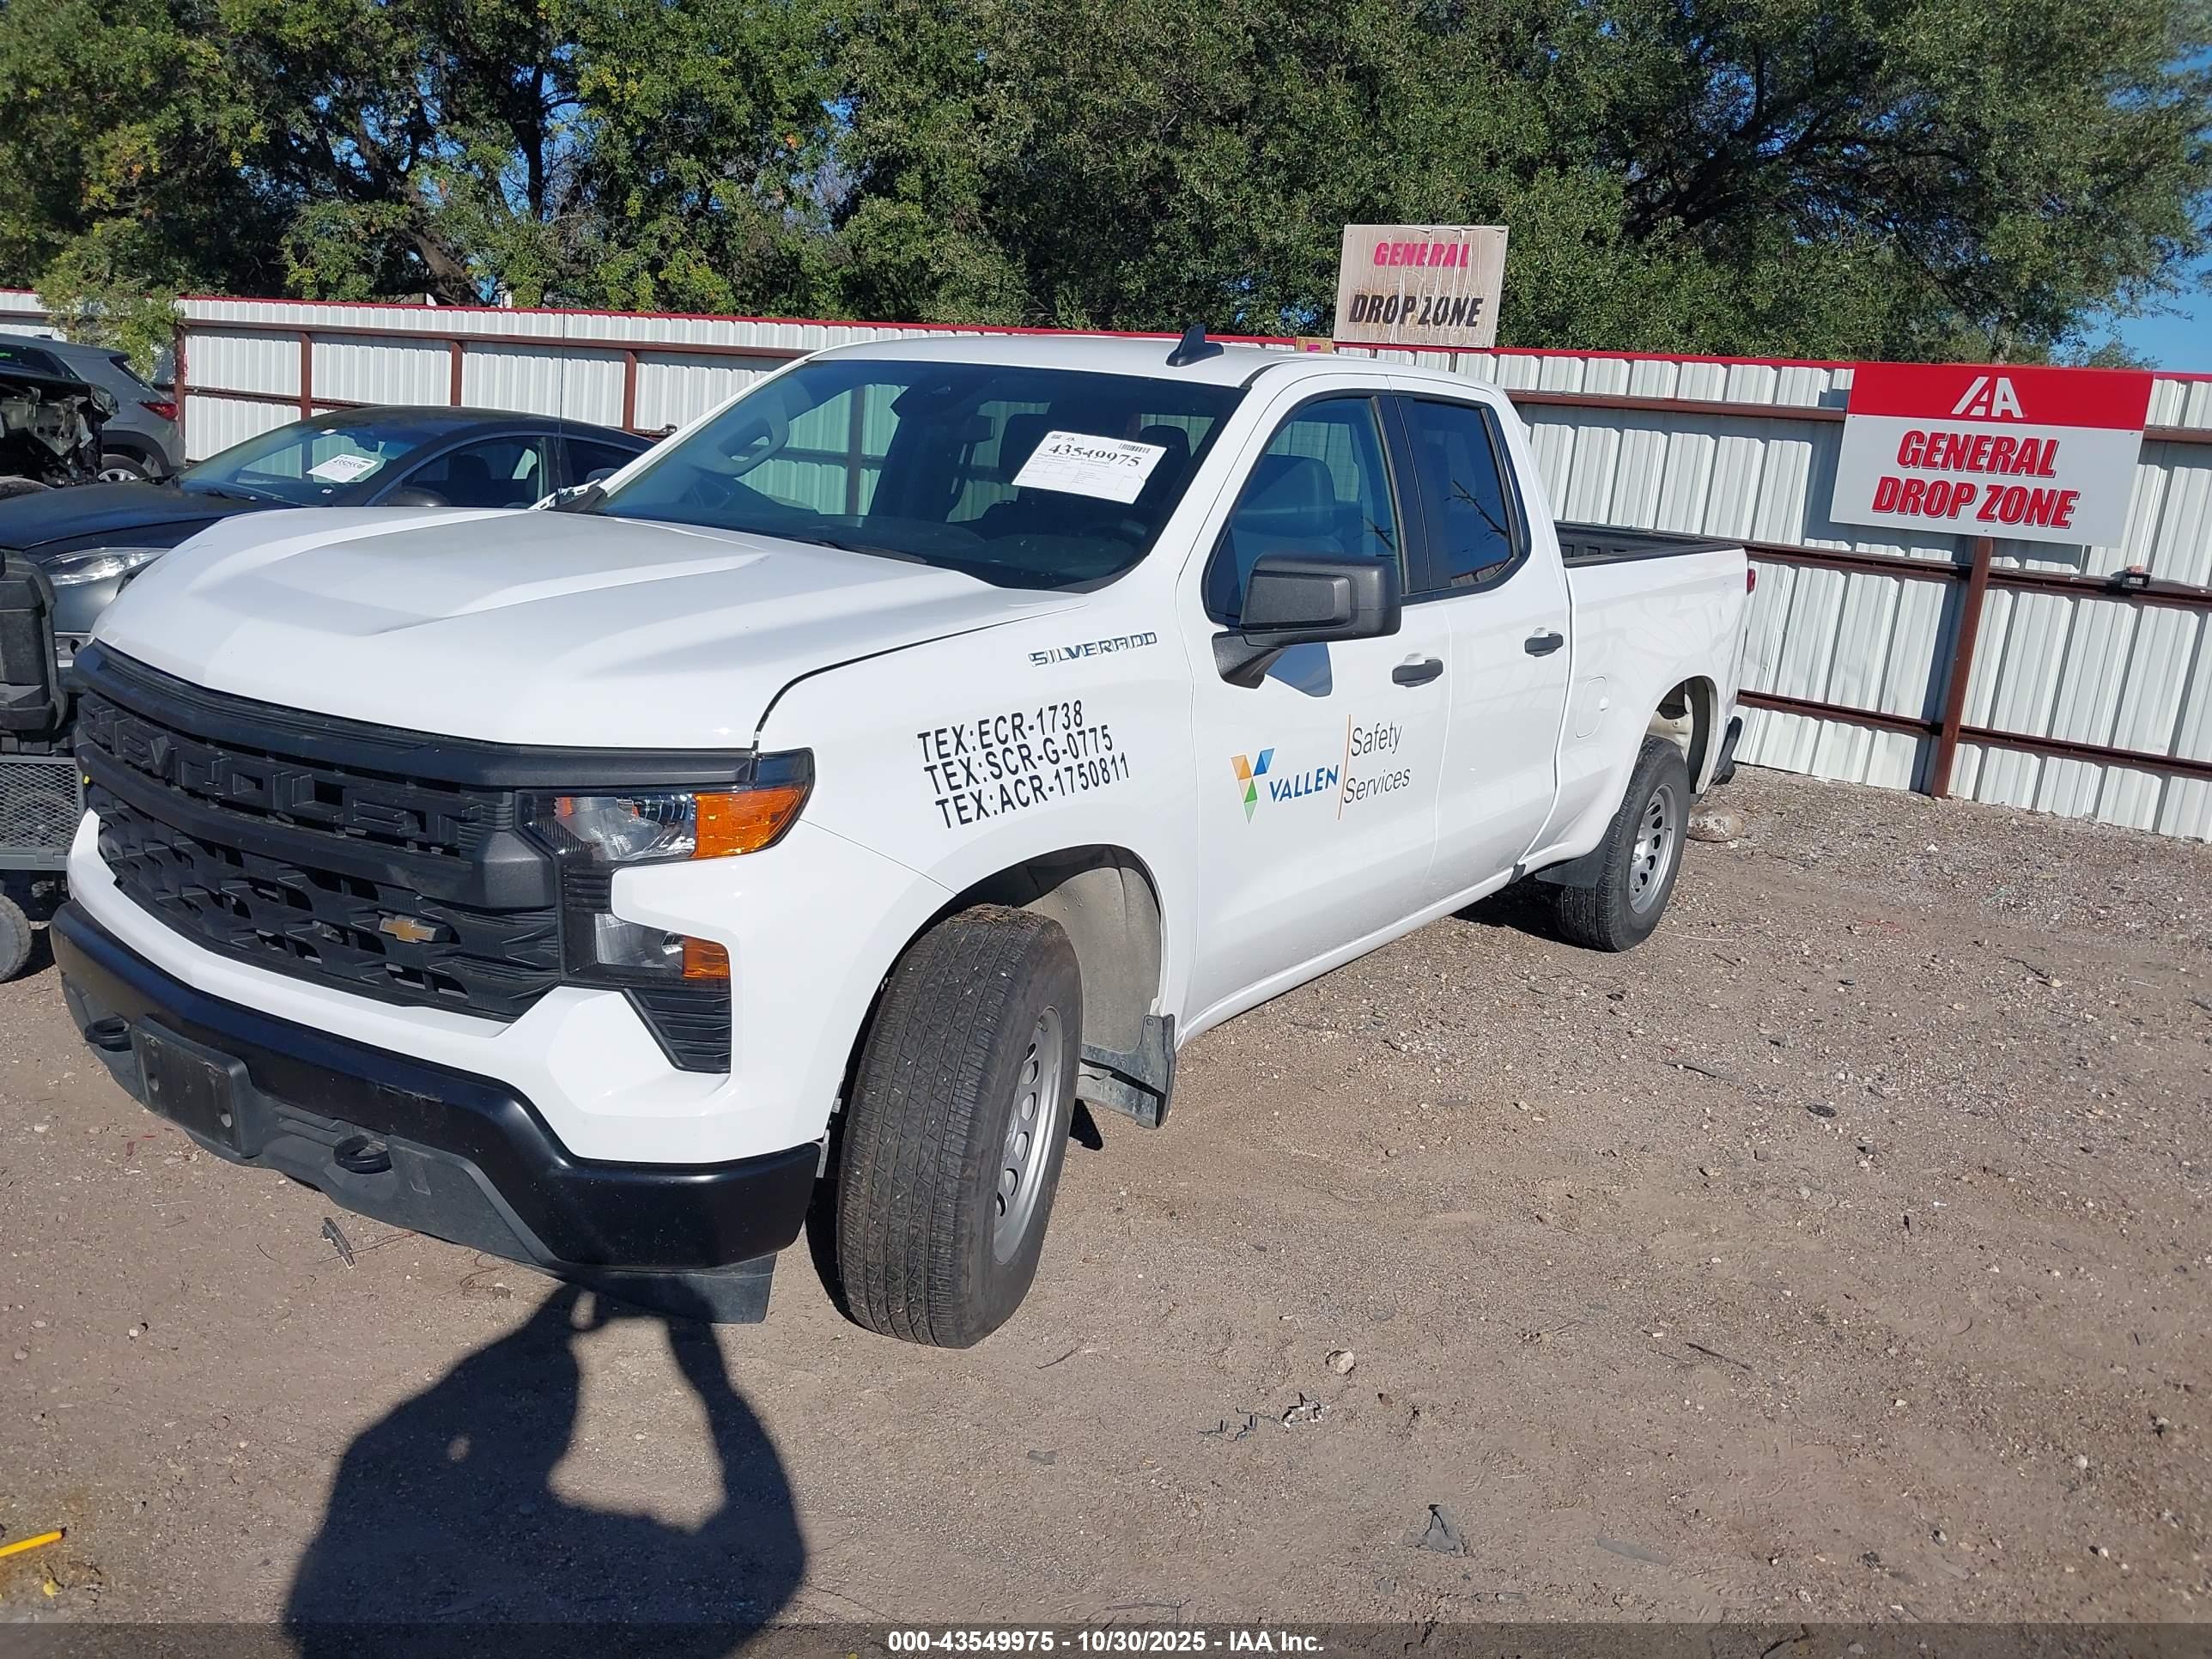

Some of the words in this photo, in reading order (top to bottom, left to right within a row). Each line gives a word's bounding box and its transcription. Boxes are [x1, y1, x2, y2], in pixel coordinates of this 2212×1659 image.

[1374, 242, 1471, 268] GENERAL
[1349, 294, 1417, 325] DROP
[1418, 295, 1484, 327] ZONE
[1048, 444, 1143, 467] 43549975
[1896, 429, 2060, 478] GENERAL
[1871, 476, 1978, 519] DROP
[1976, 483, 2081, 530] ZONE
[1029, 631, 1158, 667] SILVERADO
[917, 700, 1084, 763] TEX:ECR-1738
[1351, 720, 1402, 757] Safety
[924, 724, 1113, 794] TEX:SCR-G-0775
[935, 752, 1129, 829] TEX:ACR-1750811
[1269, 764, 1339, 803] VALLEN
[1343, 768, 1411, 804] Services
